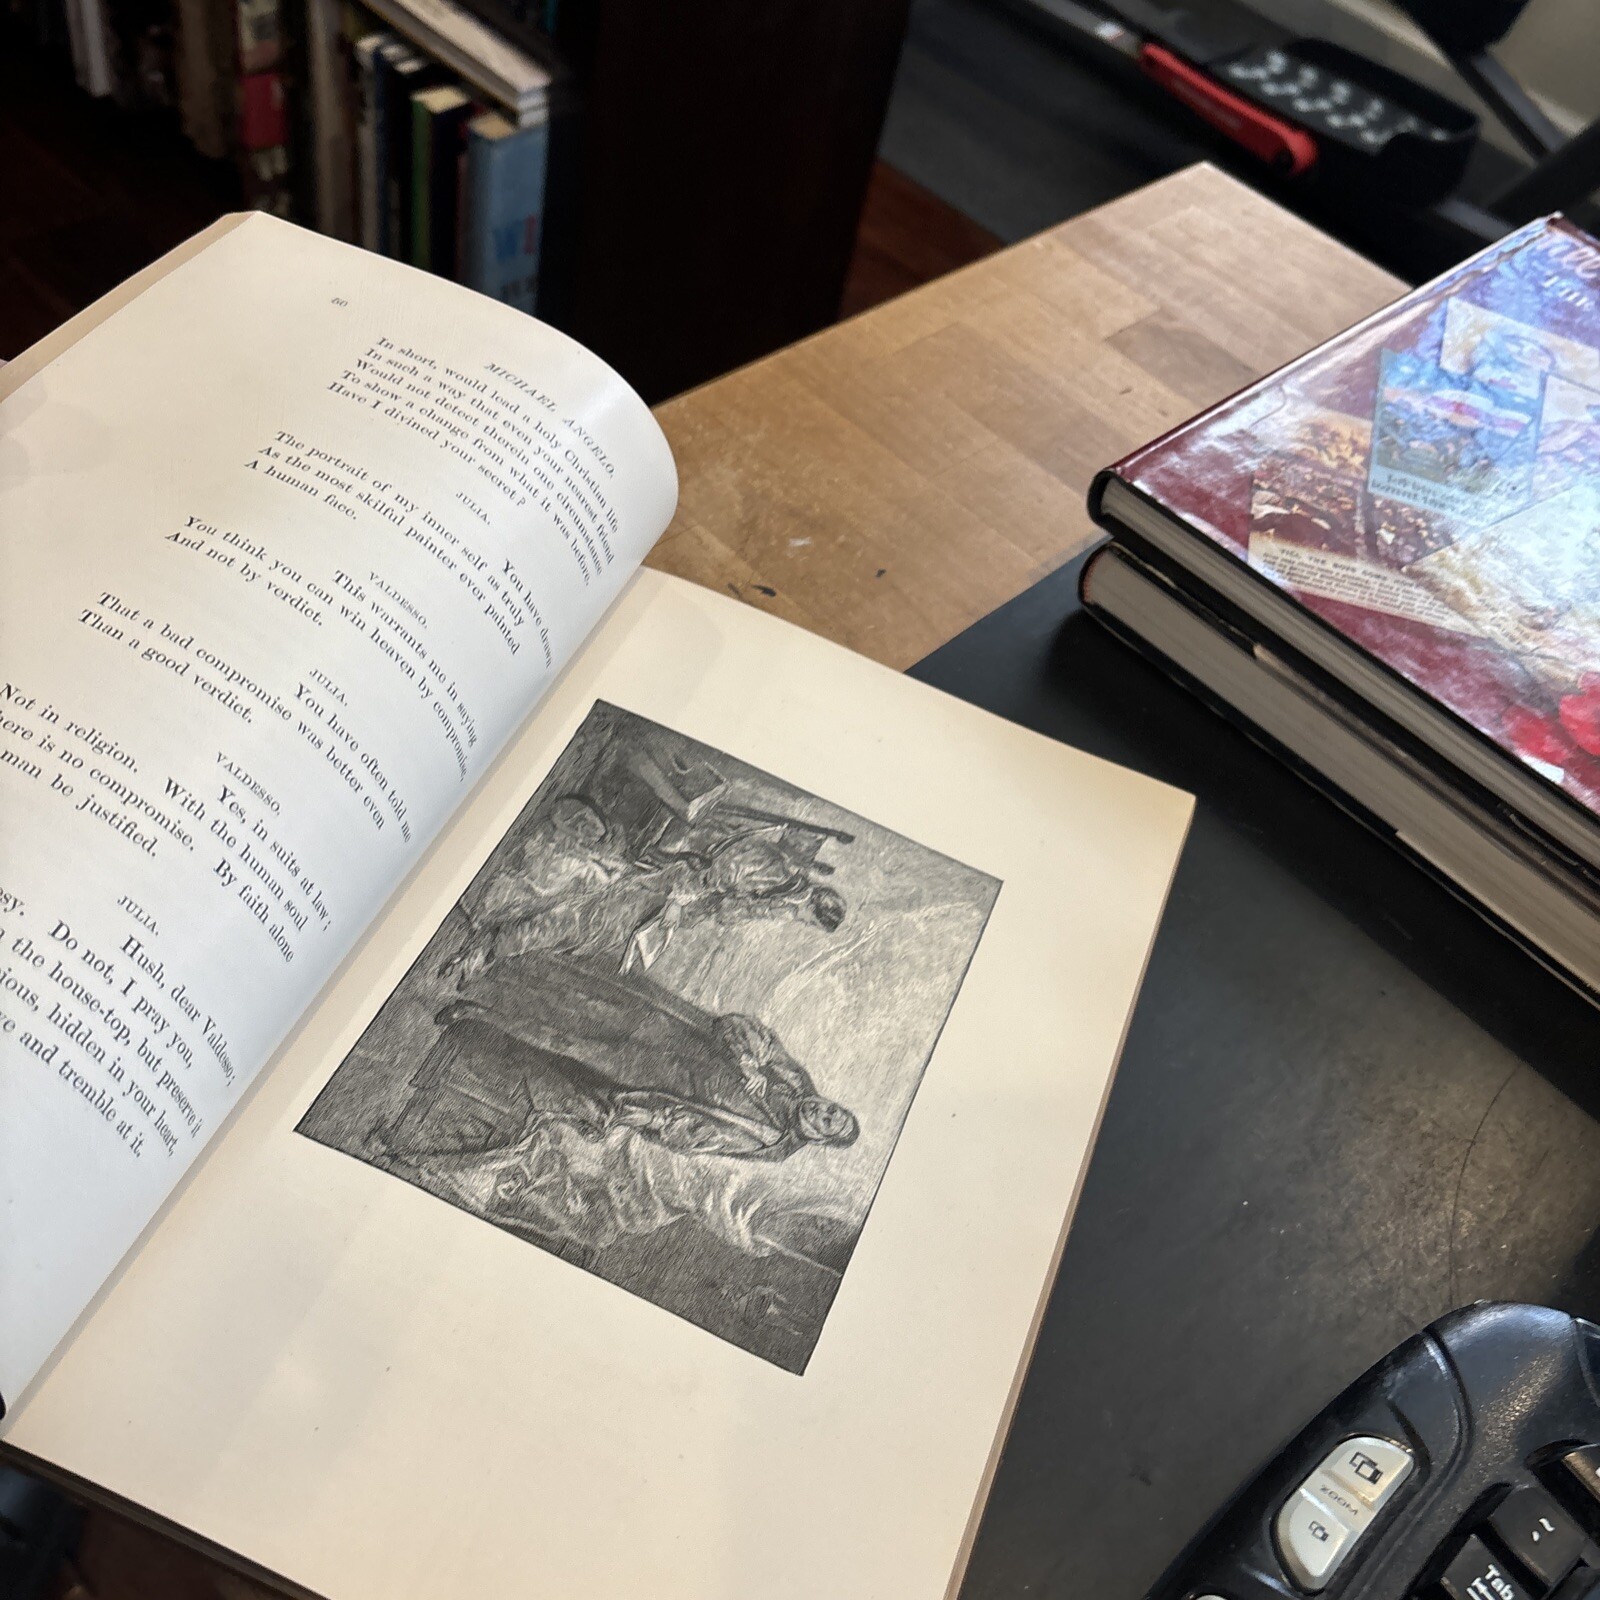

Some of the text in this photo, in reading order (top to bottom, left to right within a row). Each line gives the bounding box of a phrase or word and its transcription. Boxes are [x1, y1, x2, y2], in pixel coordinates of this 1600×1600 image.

[328, 382, 367, 403] Have
[371, 400, 382, 409] I
[385, 407, 439, 439] divined
[440, 440, 475, 463] your
[342, 370, 360, 384] To
[365, 382, 402, 401] show
[406, 401, 414, 409] a
[420, 407, 468, 439] change
[473, 438, 503, 465] from
[510, 466, 539, 498] what
[540, 497, 550, 512] it
[554, 513, 570, 540] was
[357, 359, 602, 575] Would not detect therein one circumstance
[365, 349, 382, 361] In
[387, 359, 418, 376] such
[438, 381, 465, 399] way
[471, 398, 499, 420] that
[503, 420, 532, 445] even
[534, 447, 563, 473] your
[565, 477, 598, 523] nearest
[597, 524, 614, 564] friend
[377, 338, 618, 533] In short, would lead a holy Christian life
[485, 362, 557, 412] MICHAEL
[563, 418, 615, 478] ANGELO.
[244, 460, 357, 520] A human face.
[275, 431, 524, 626] The portrait of my inner self as truly
[456, 491, 491, 525] JULIA.
[165, 532, 323, 626] And not by verdict.
[184, 516, 217, 535] You
[223, 532, 267, 560] think
[269, 559, 302, 583] you
[307, 583, 333, 605] can
[340, 605, 366, 632] win
[370, 628, 415, 679] heaven
[419, 677, 433, 699] by
[259, 447, 520, 656] As the most skilful painter ever painted
[370, 572, 428, 629] VALDESSO.
[502, 559, 523, 592] You
[524, 592, 541, 626] have
[78, 609, 252, 723] Than a good verdict.
[97, 592, 385, 830] That a bad compromise was better even
[309, 669, 348, 706] JULIA.
[332, 570, 478, 748] This warrants me in saying
[0, 750, 158, 857] man be justified.
[0, 683, 309, 932] Not in religion. With the human soul
[216, 751, 280, 815] VALDESSO.
[295, 683, 411, 843] You have often told me
[38, 735, 56, 752] is
[59, 750, 84, 769] no
[90, 768, 194, 851] compromise.
[213, 857, 237, 887] By
[237, 885, 270, 924] faith
[269, 924, 294, 962] alone
[218, 785, 246, 824] Yes,
[252, 819, 268, 842] in
[270, 841, 300, 877] suits
[300, 878, 315, 895] at
[118, 895, 159, 936] JULIA.
[12, 937, 202, 1138] the house-top, but preserve it
[48, 920, 78, 950] Do
[81, 949, 114, 984] not,
[120, 977, 138, 997] I
[132, 996, 170, 1034] pray
[166, 1032, 194, 1069] you,
[120, 934, 165, 989] Hush,
[171, 985, 201, 1022] dear
[20, 1032, 59, 1064] and
[59, 1060, 117, 1122] tremble
[117, 1120, 133, 1140] at
[130, 1132, 143, 1157] it.
[47, 1002, 106, 1063] hidden
[108, 1057, 125, 1083] in
[122, 1080, 156, 1116] your
[154, 1110, 179, 1157] heart,
[1320, 1485, 1359, 1517] ZOOM
[1485, 1564, 1514, 1600] Tab
